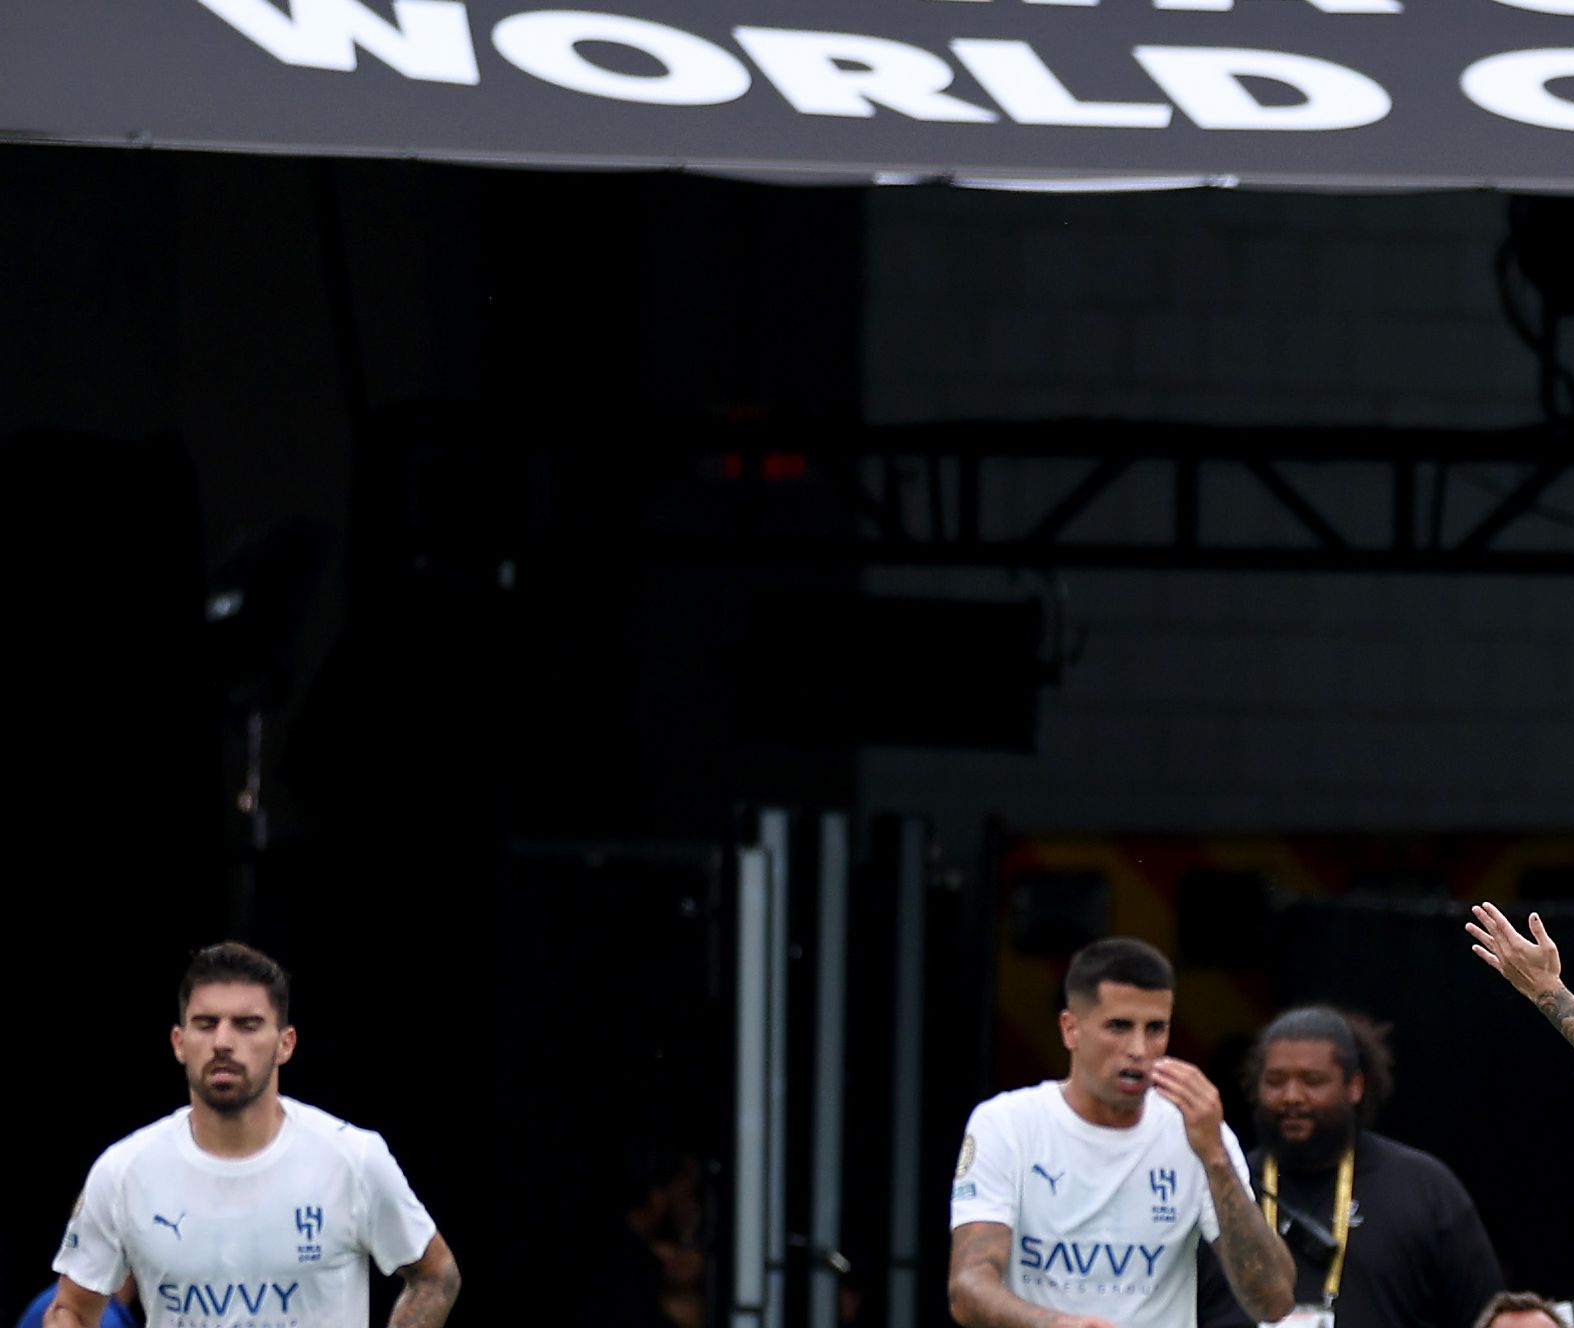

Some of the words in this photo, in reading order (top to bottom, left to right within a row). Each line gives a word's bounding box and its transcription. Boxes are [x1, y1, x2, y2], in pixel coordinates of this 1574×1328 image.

[197, 0, 1393, 130] WORLD
[1020, 1235, 1166, 1277] SAVVY
[158, 1282, 298, 1316] SAVVY
